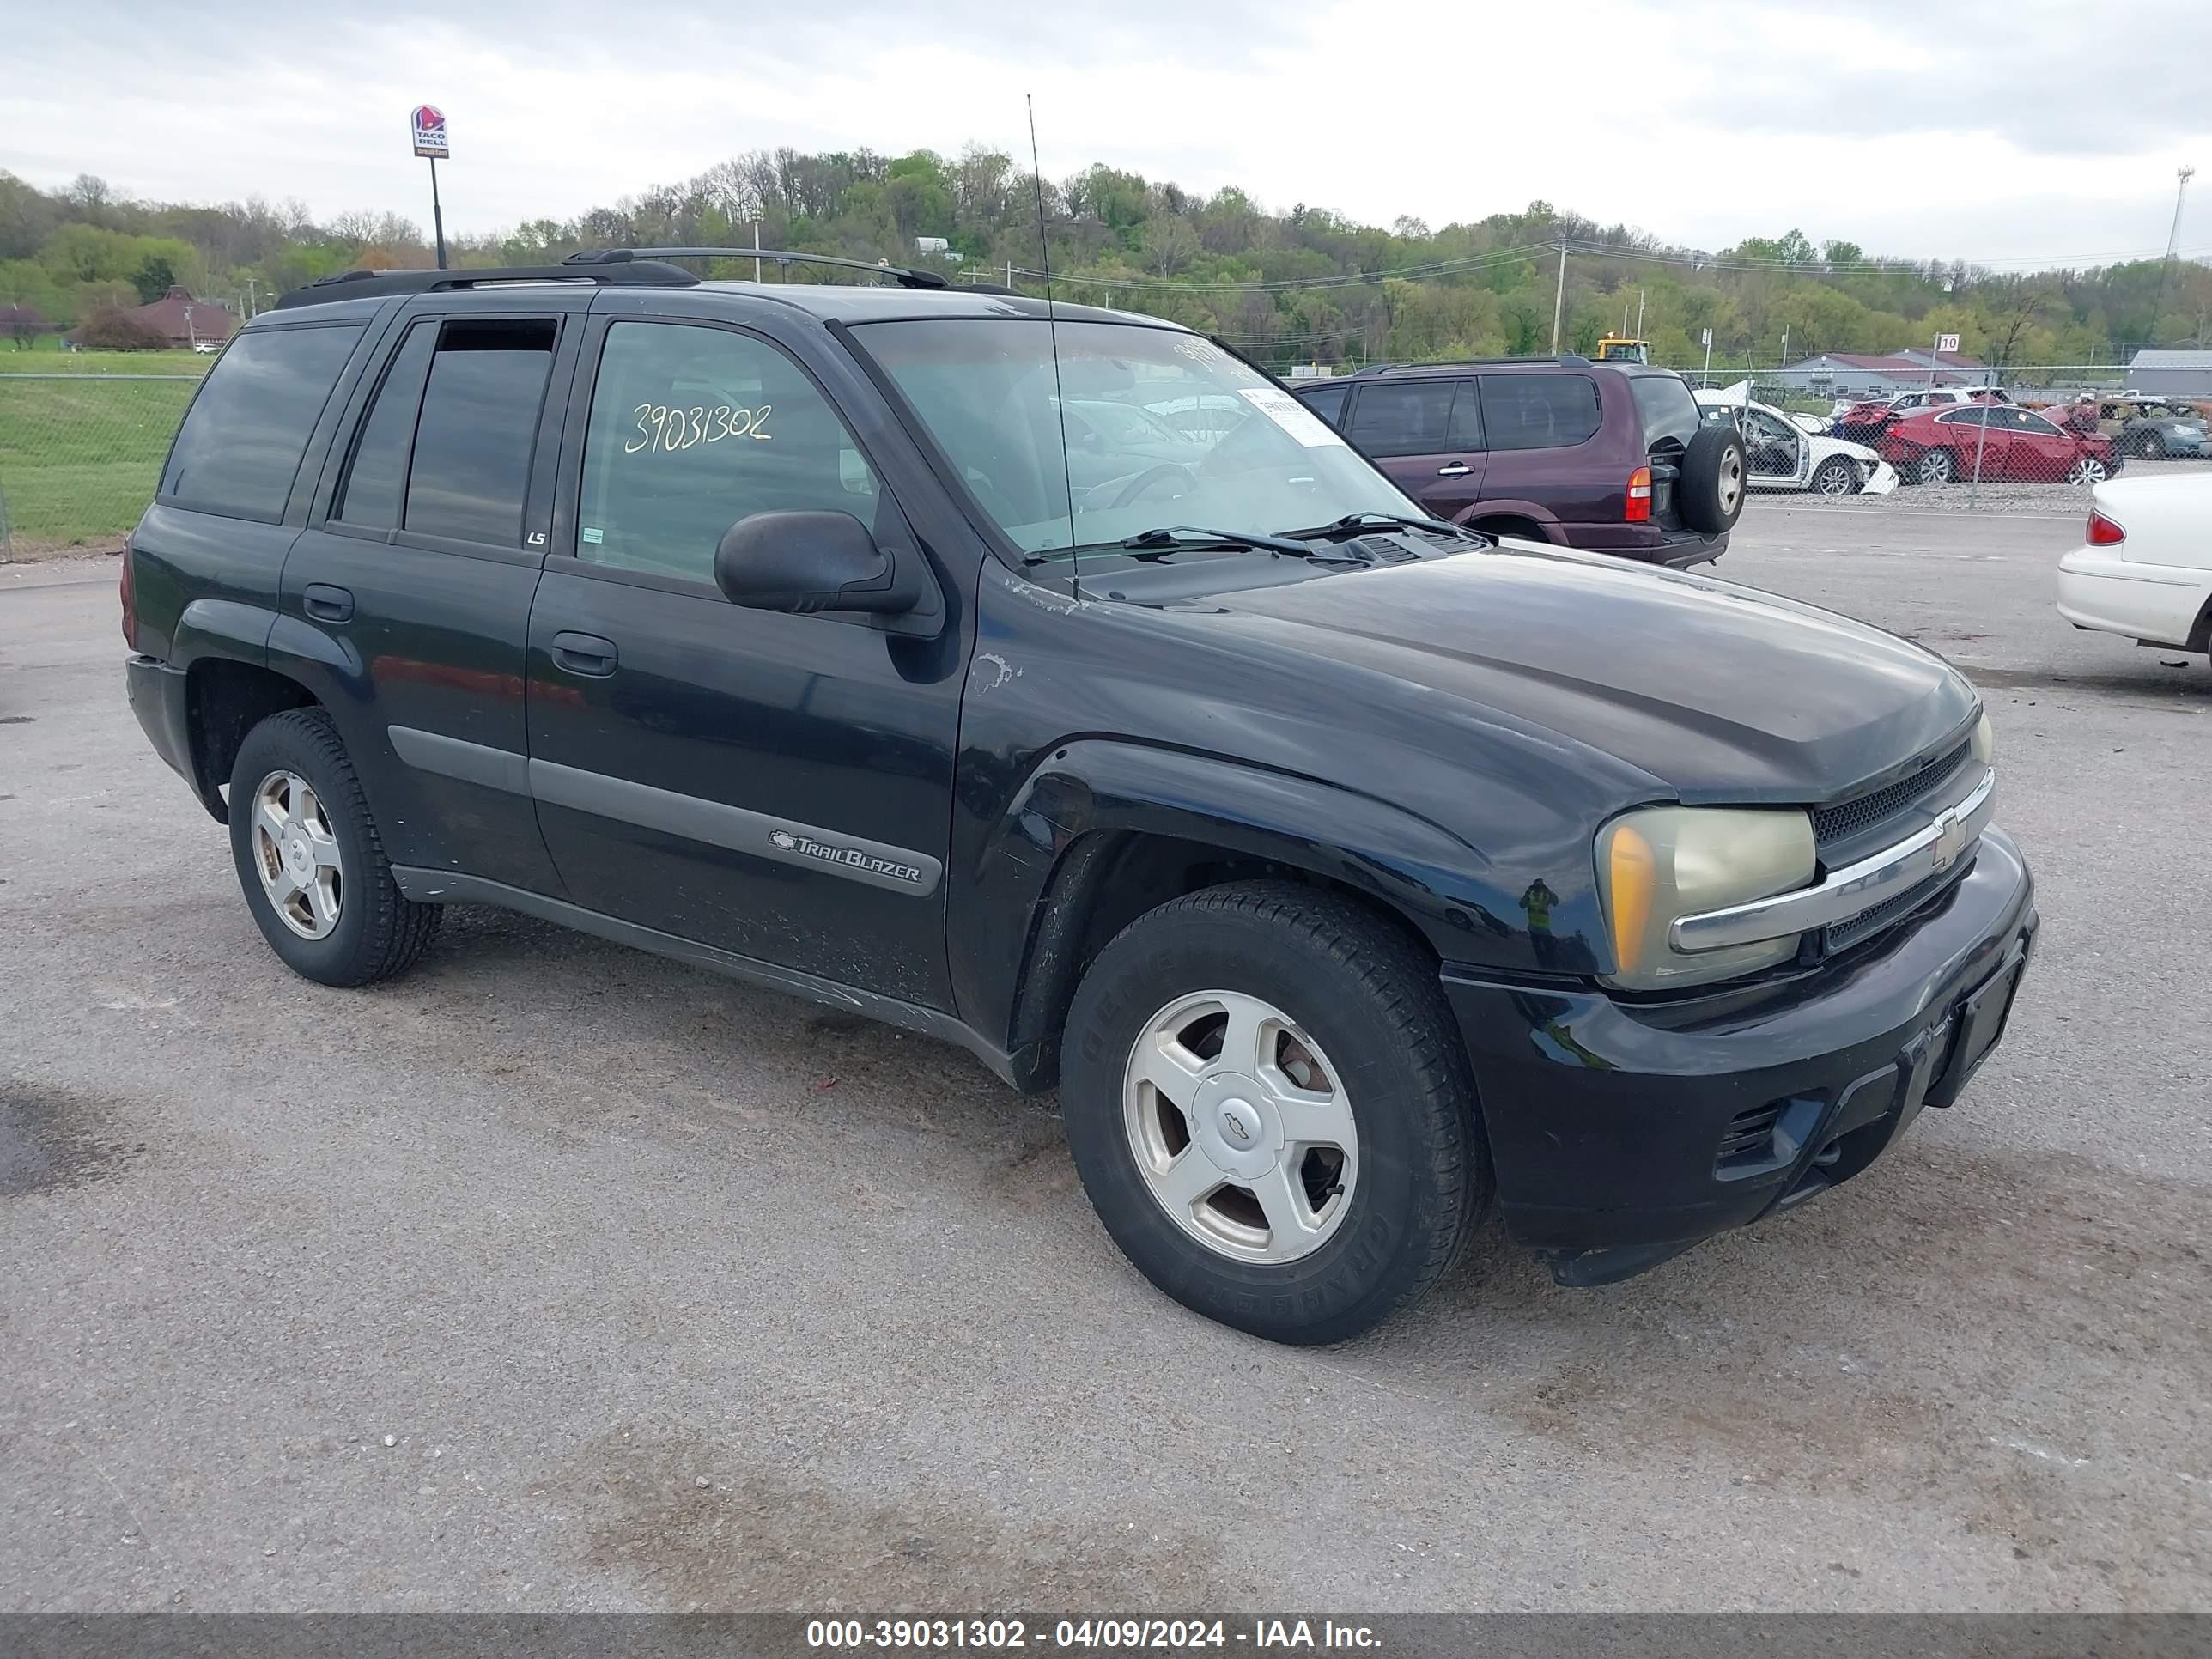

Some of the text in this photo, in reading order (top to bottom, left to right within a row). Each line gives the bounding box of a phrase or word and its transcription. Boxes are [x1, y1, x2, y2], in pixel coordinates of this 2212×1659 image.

[1942, 337, 1957, 349] 10
[624, 404, 773, 454] 39031302
[527, 532, 546, 545] LS
